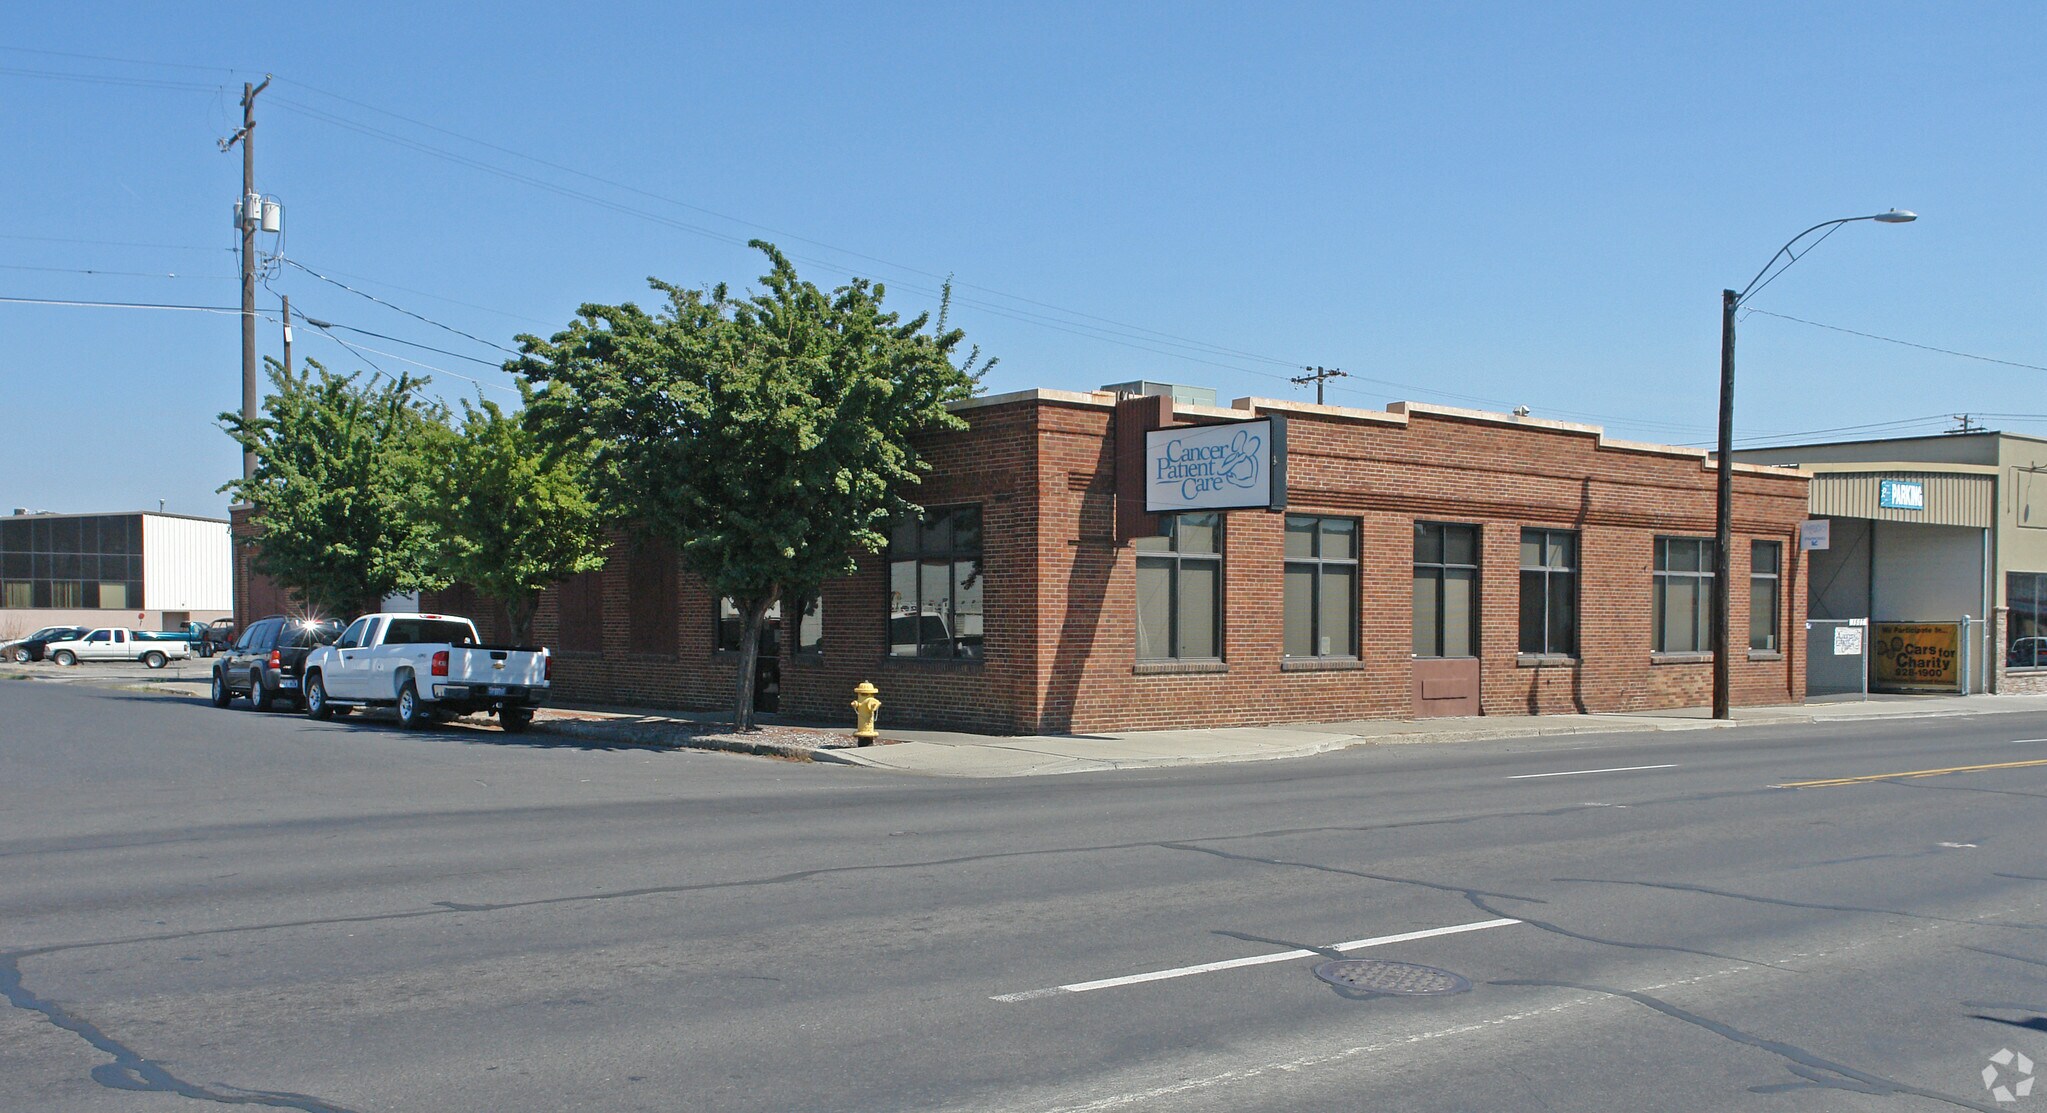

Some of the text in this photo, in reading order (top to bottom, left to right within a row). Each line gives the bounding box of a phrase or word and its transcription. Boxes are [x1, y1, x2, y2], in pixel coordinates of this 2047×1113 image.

[1167, 439, 1230, 463] Cancer
[1157, 457, 1216, 480] Patient
[1181, 477, 1224, 500] Care
[1891, 483, 1923, 507] PARKING
[1896, 652, 1951, 671] Charity
[1905, 643, 1956, 658] Cars for
